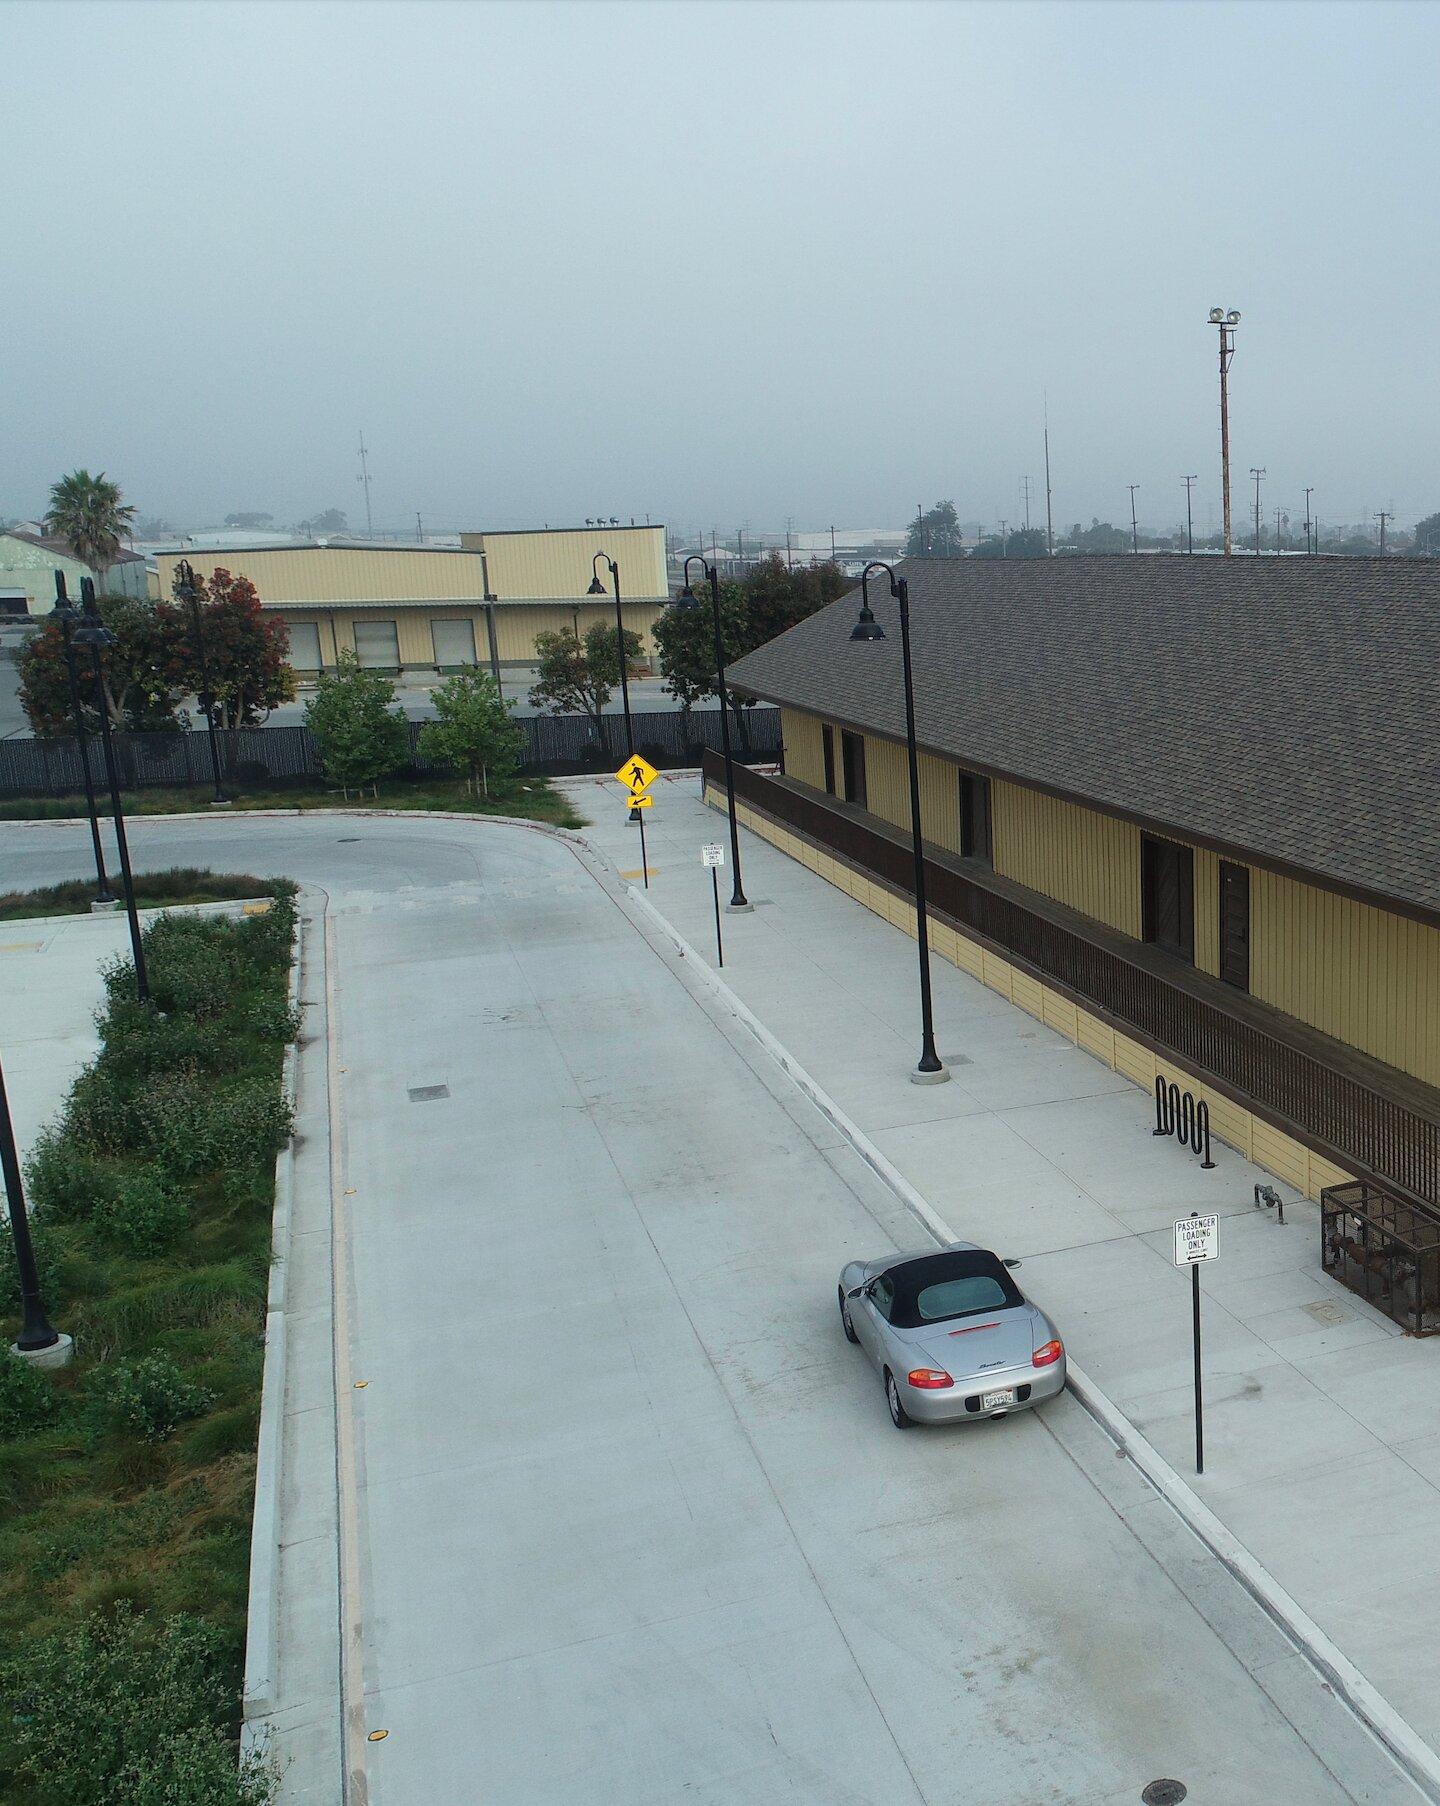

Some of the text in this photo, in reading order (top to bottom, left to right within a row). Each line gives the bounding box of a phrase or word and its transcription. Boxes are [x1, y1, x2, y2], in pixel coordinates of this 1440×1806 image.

[1177, 1217, 1216, 1232] PASSENGER
[1182, 1227, 1211, 1241] LOADING
[1188, 1238, 1206, 1250] ONLY
